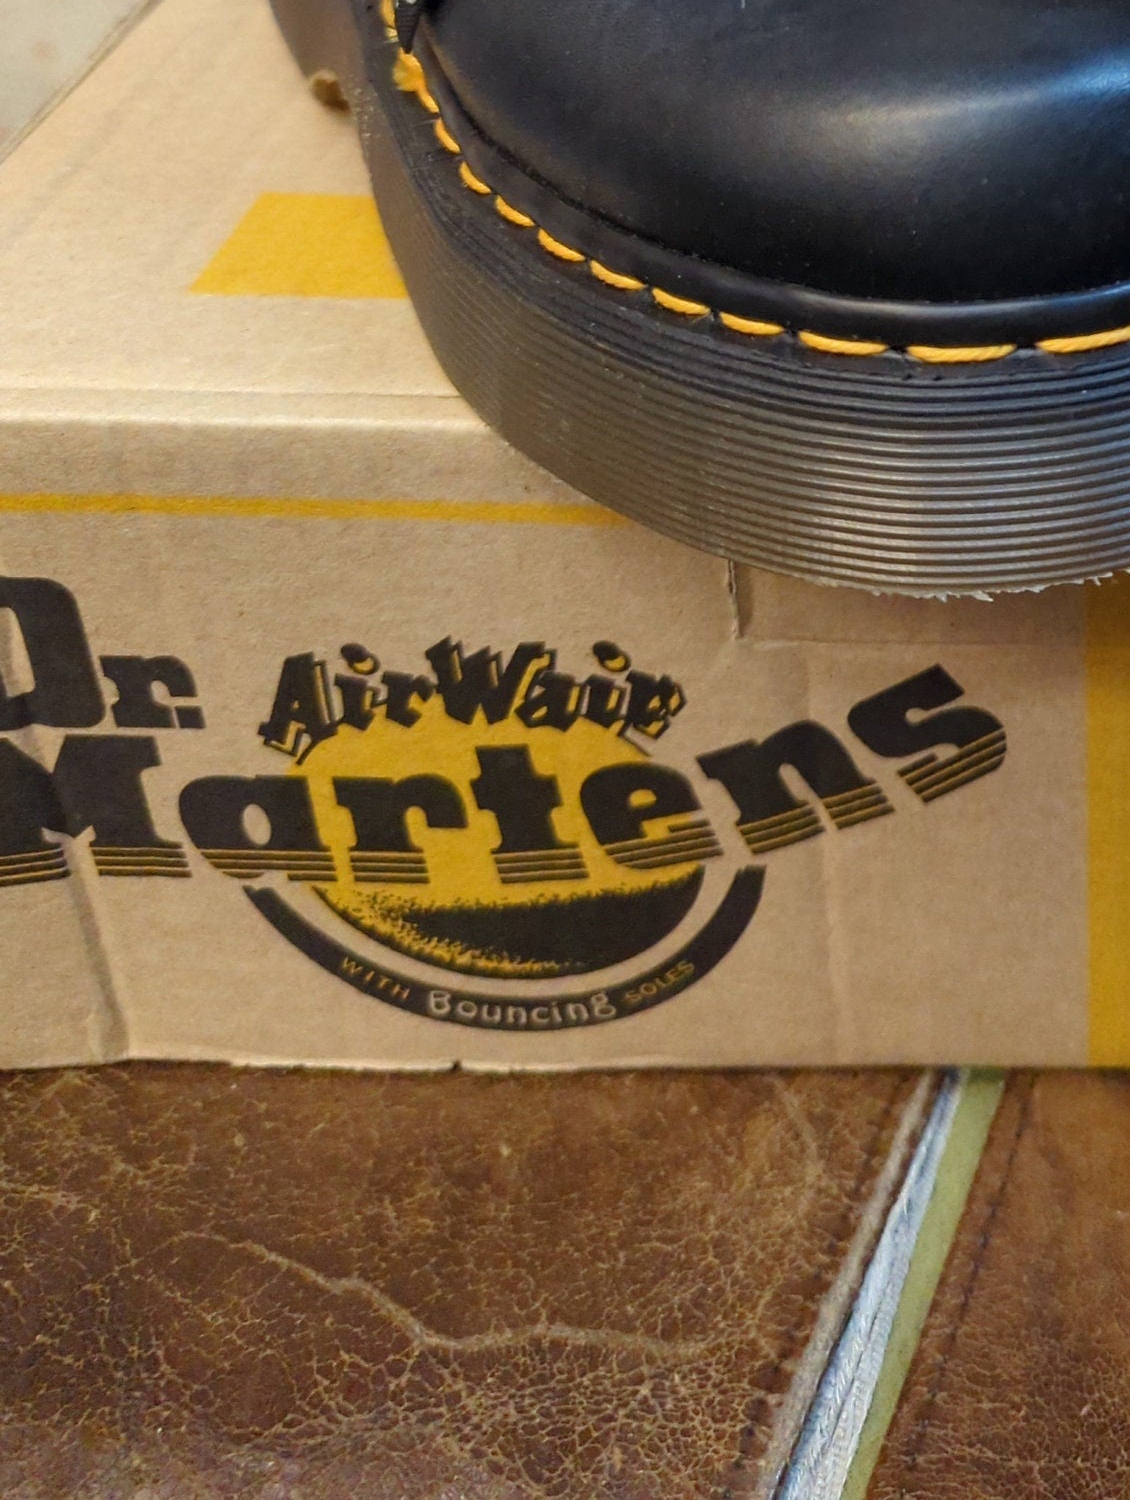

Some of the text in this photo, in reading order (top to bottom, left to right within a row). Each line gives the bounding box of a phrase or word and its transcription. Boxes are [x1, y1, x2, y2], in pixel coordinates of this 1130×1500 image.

[258, 638, 687, 765] AirWair
[0, 664, 1008, 886] Martens
[342, 955, 696, 1027] WITH Bouncing SOLES
